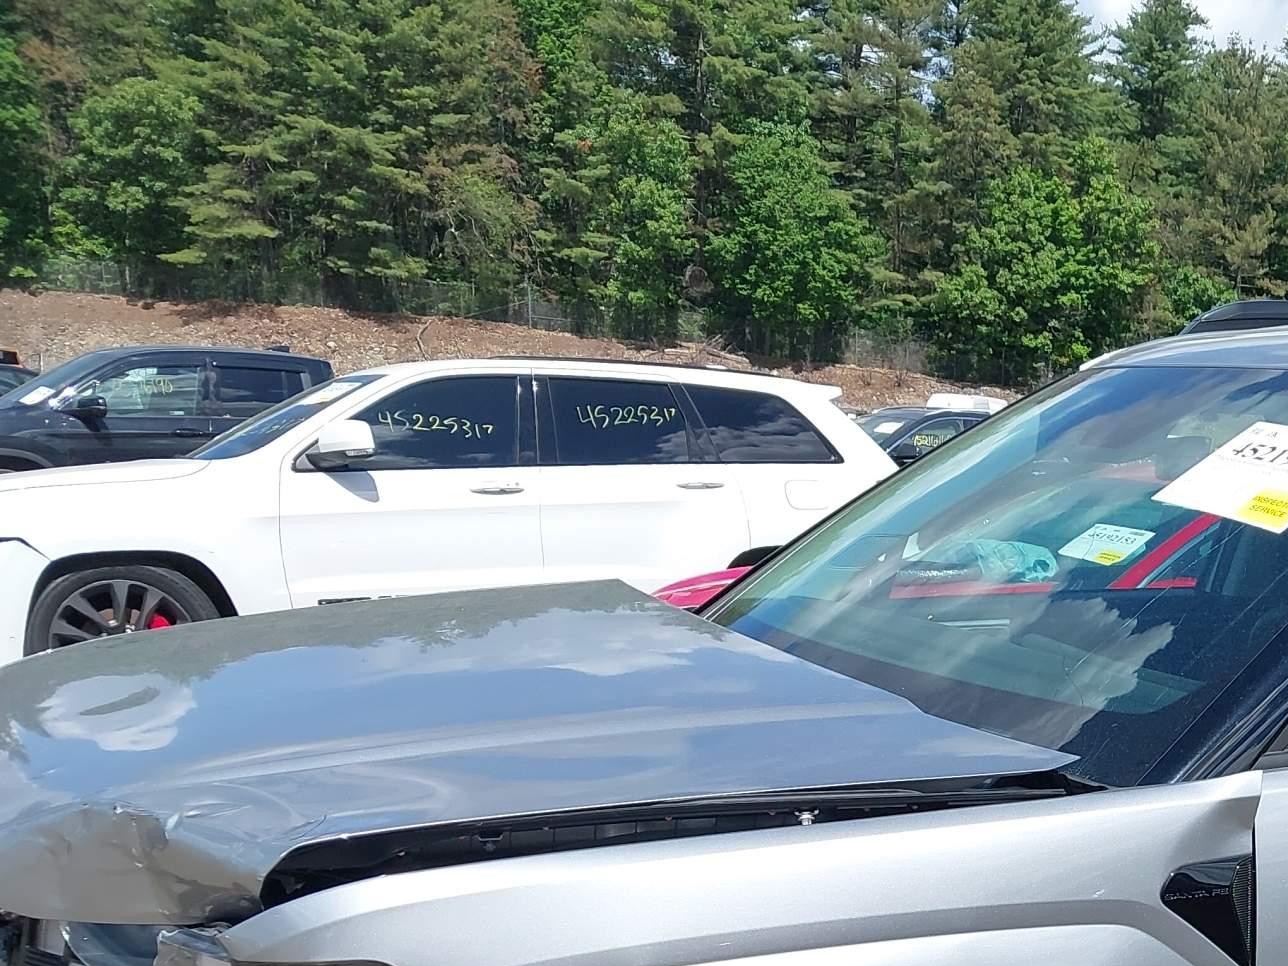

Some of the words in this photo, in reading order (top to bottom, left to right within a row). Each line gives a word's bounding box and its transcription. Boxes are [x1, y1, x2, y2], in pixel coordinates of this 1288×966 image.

[378, 411, 494, 439] 45225317
[576, 405, 676, 429] 45225317
[1248, 505, 1286, 518] SERVICE
